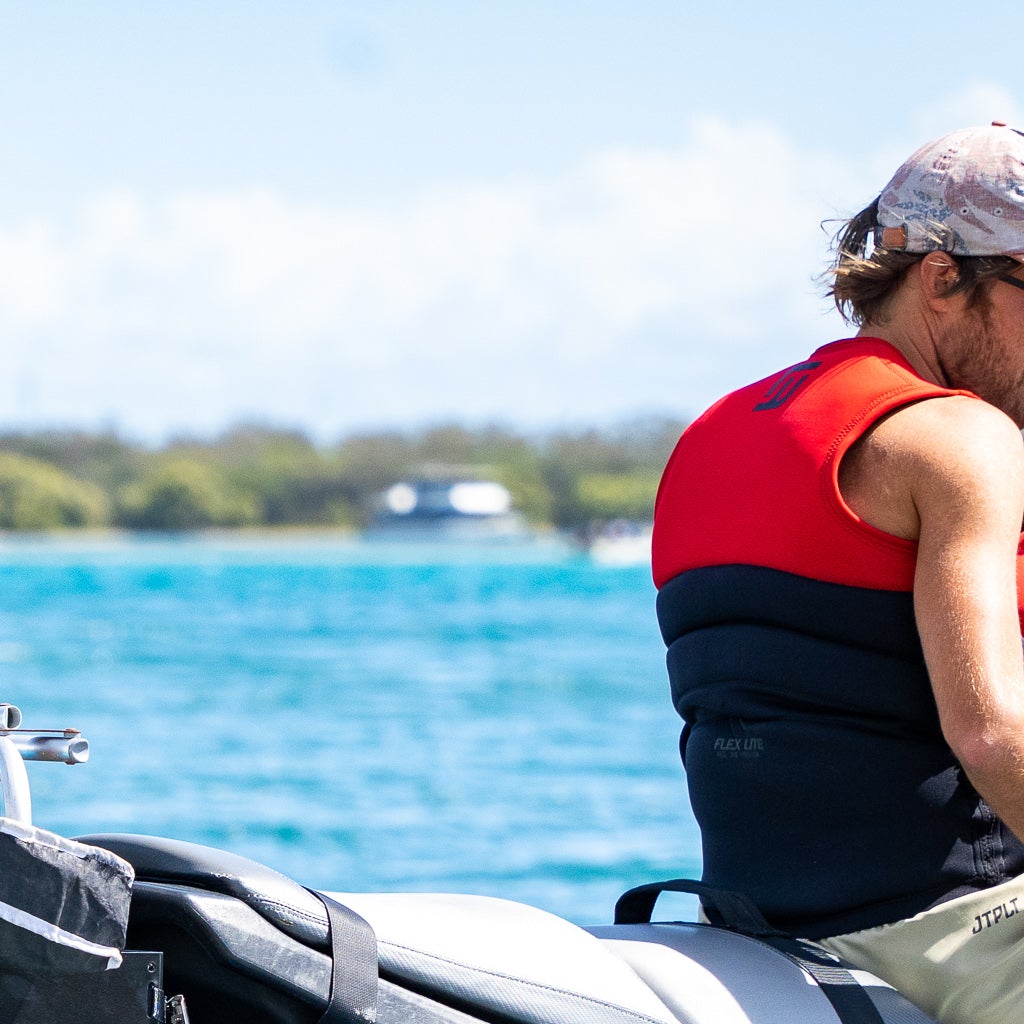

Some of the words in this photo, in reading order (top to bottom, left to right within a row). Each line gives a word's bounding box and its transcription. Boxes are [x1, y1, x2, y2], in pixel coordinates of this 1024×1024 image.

[713, 738, 741, 751] FLEX
[743, 738, 764, 750] LITE
[972, 898, 1019, 935] JTPLT
